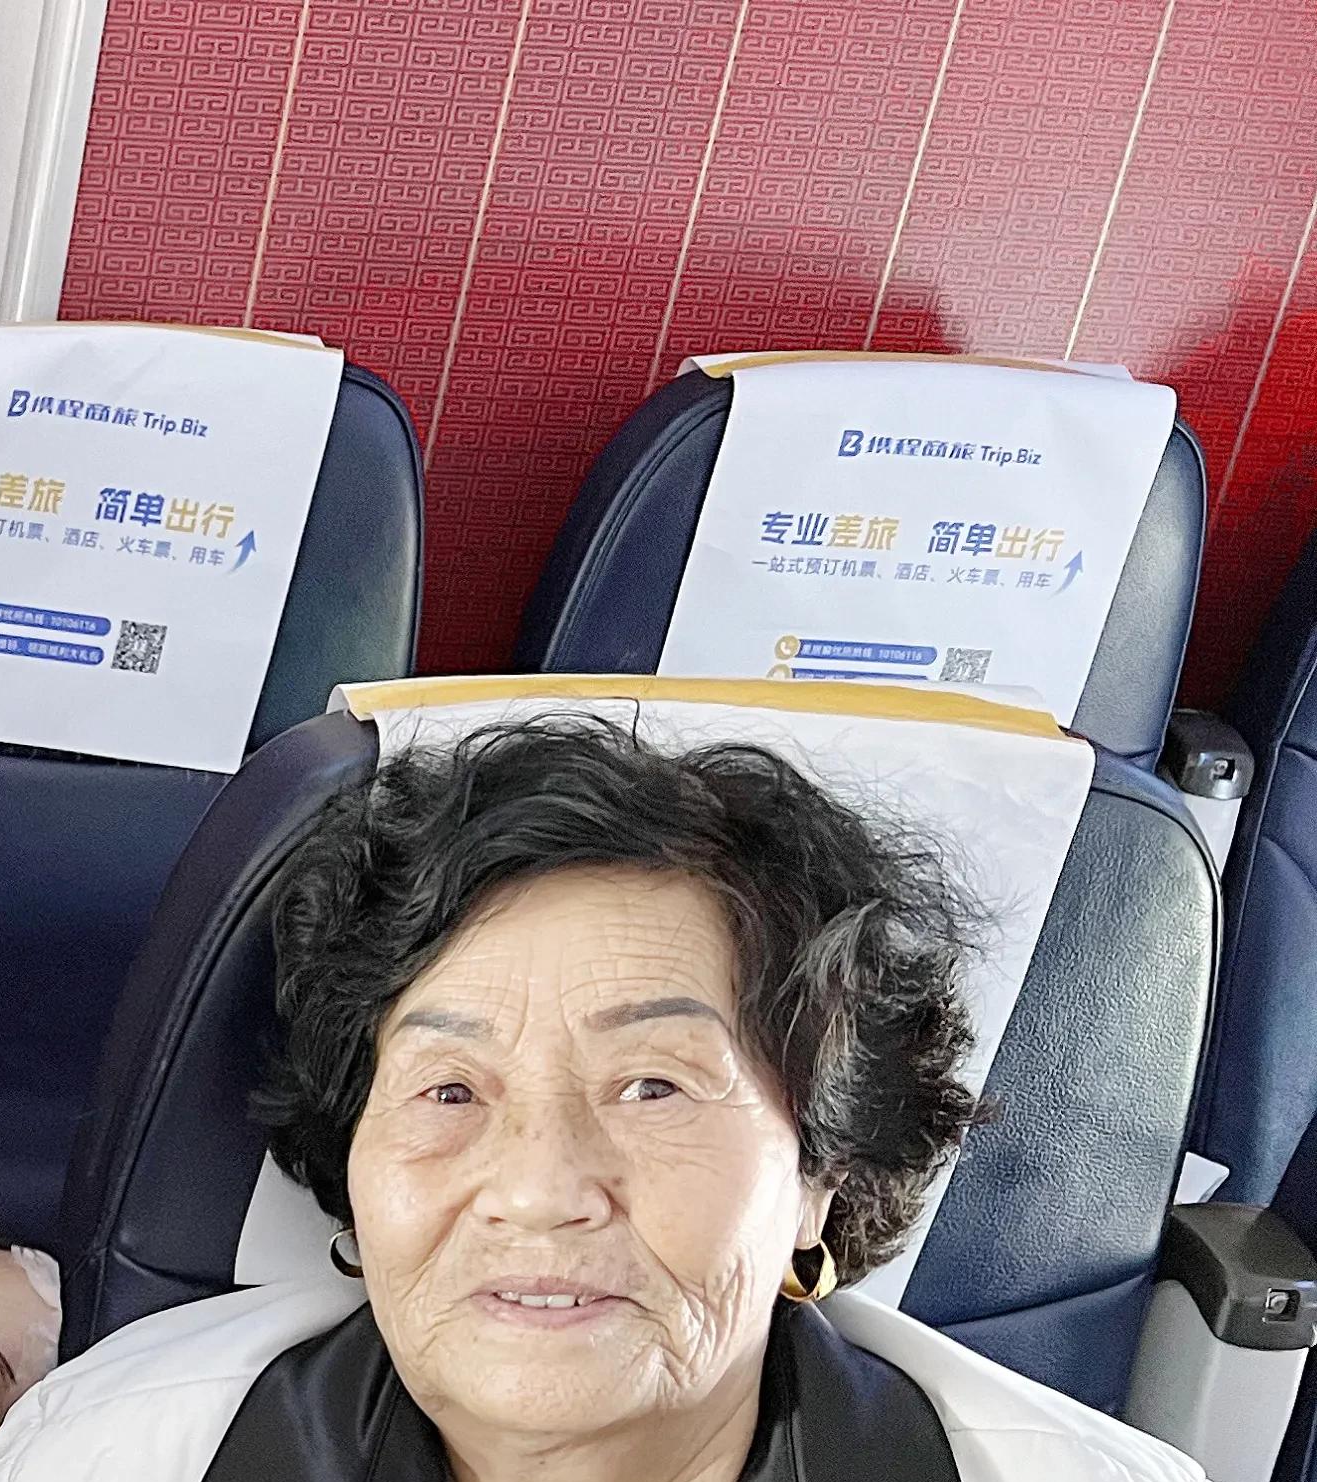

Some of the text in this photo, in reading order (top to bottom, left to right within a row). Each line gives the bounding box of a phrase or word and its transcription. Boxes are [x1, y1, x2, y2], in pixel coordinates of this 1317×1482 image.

[142, 411, 208, 438] Trip.Biz
[980, 445, 1042, 467] Trip.Biz
[95, 487, 236, 539] 简单出行
[761, 511, 1065, 563] 专业差旅 简单出行
